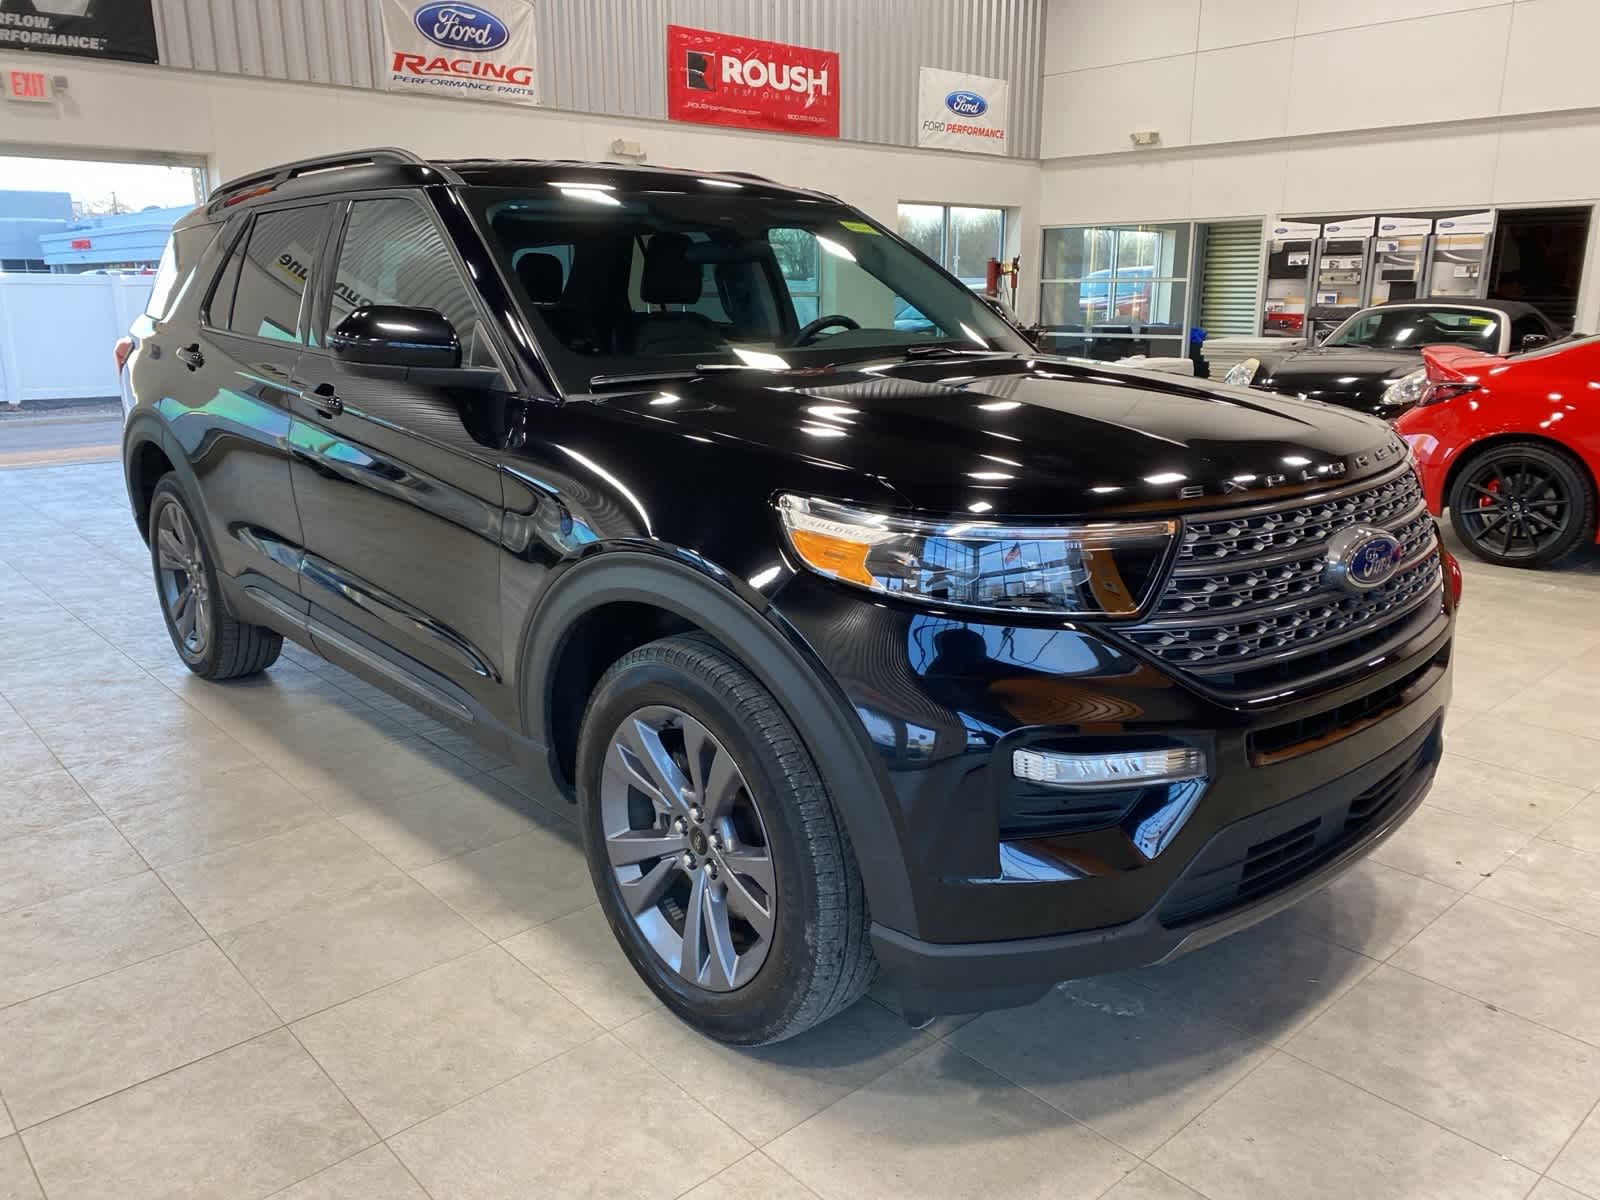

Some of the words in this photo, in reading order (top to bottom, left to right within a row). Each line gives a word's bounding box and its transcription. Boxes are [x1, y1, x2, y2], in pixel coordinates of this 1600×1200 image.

[434, 8, 492, 45] Ford
[11, 71, 45, 97] EXIT
[392, 51, 533, 86] RACING
[393, 74, 492, 92] PERFORMANCE
[498, 86, 534, 96] PARTS
[721, 55, 829, 97] ROUSH
[953, 94, 980, 113] Ford
[922, 120, 946, 133] FORD
[946, 123, 1005, 139] PERFORMANCE
[1179, 441, 1401, 499] EXPLORER
[1363, 544, 1394, 577] Ford
